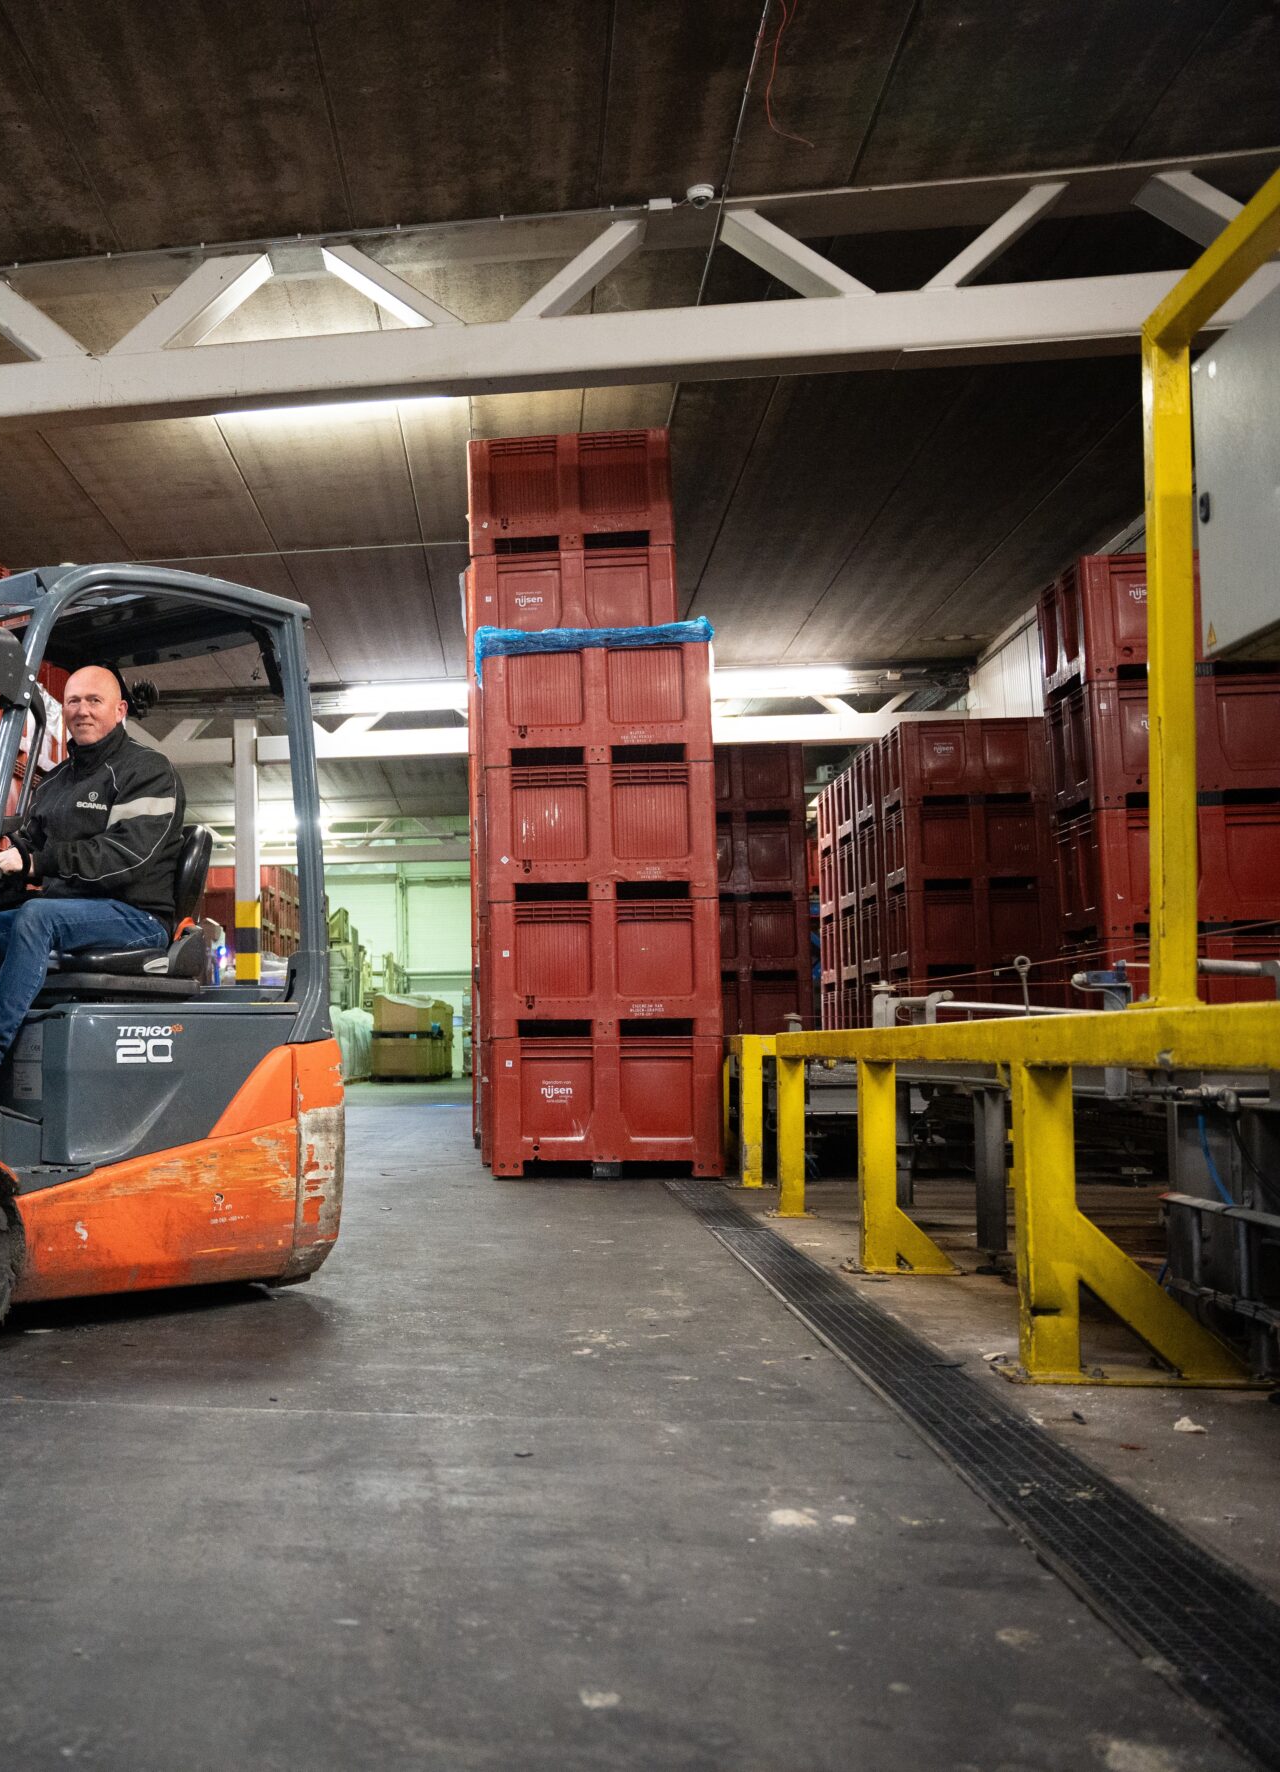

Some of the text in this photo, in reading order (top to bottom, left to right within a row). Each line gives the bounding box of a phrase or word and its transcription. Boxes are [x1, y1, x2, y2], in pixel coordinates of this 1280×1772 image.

[1129, 588, 1148, 600] nijs
[515, 596, 543, 607] nijsen
[76, 801, 107, 811] SCANIA
[116, 1039, 174, 1064] 20
[541, 1085, 573, 1098] nijsen
